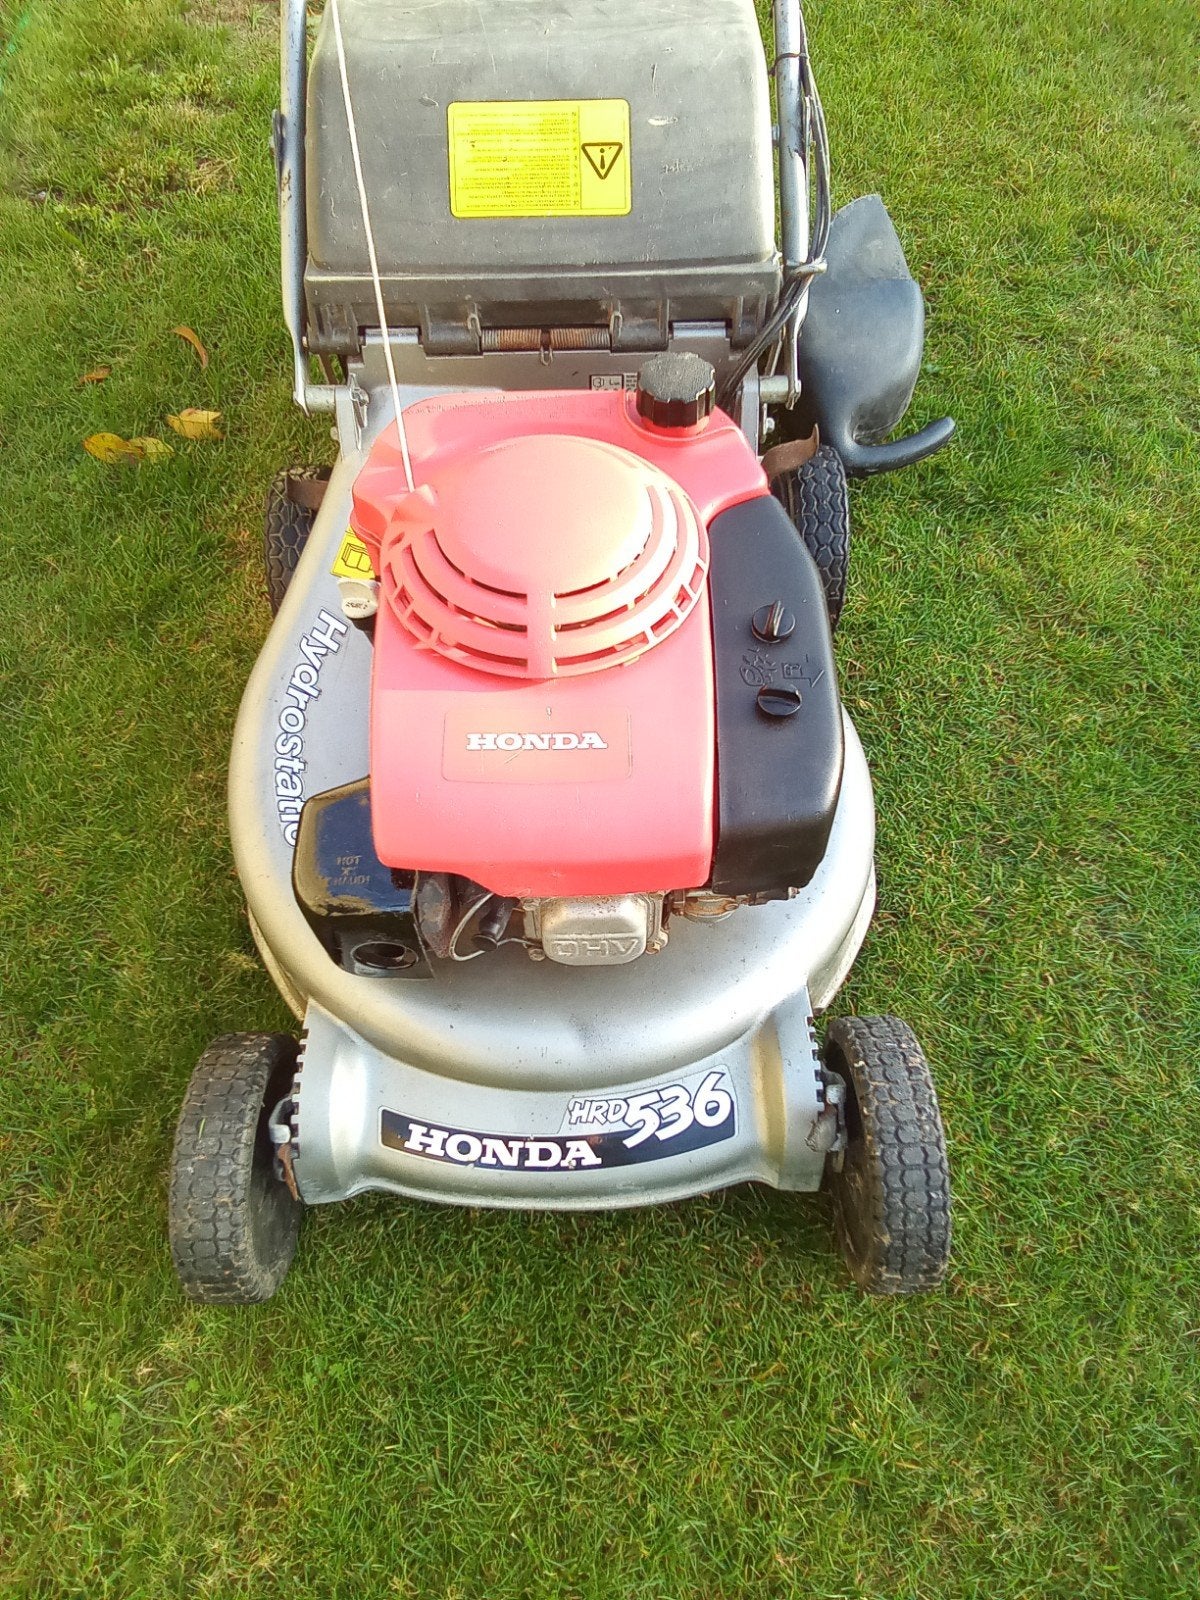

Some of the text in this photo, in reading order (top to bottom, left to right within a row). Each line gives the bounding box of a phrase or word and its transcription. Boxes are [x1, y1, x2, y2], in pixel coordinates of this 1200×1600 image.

[466, 732, 608, 751] HONDA
[552, 937, 639, 957] OHV
[403, 1123, 602, 1167] HONDA
